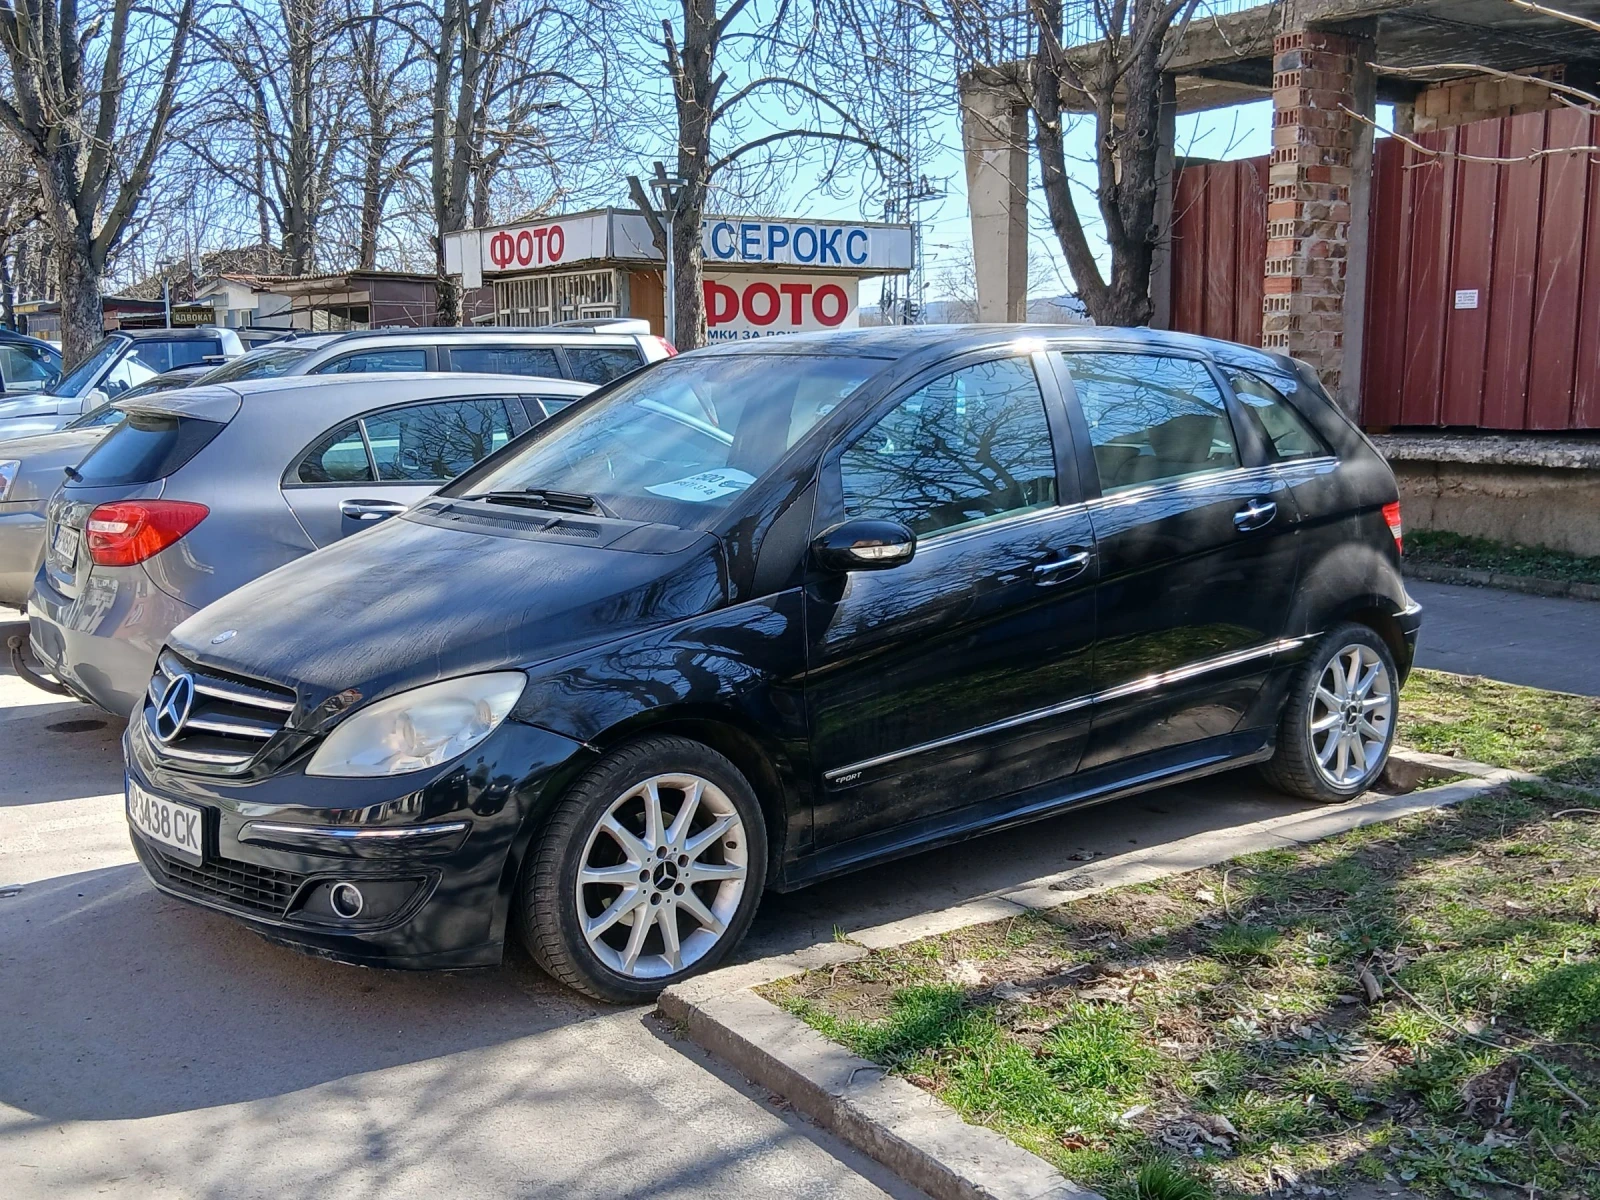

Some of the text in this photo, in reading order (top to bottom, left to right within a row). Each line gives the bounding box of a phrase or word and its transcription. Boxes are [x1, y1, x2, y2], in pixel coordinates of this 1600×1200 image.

[490, 225, 565, 269] ФОТО
[702, 222, 868, 265] СЕРОКС
[175, 313, 212, 323] АДВОКАТ
[742, 330, 761, 340] ЗА
[835, 771, 863, 784] SPORT
[174, 809, 198, 850] CK
